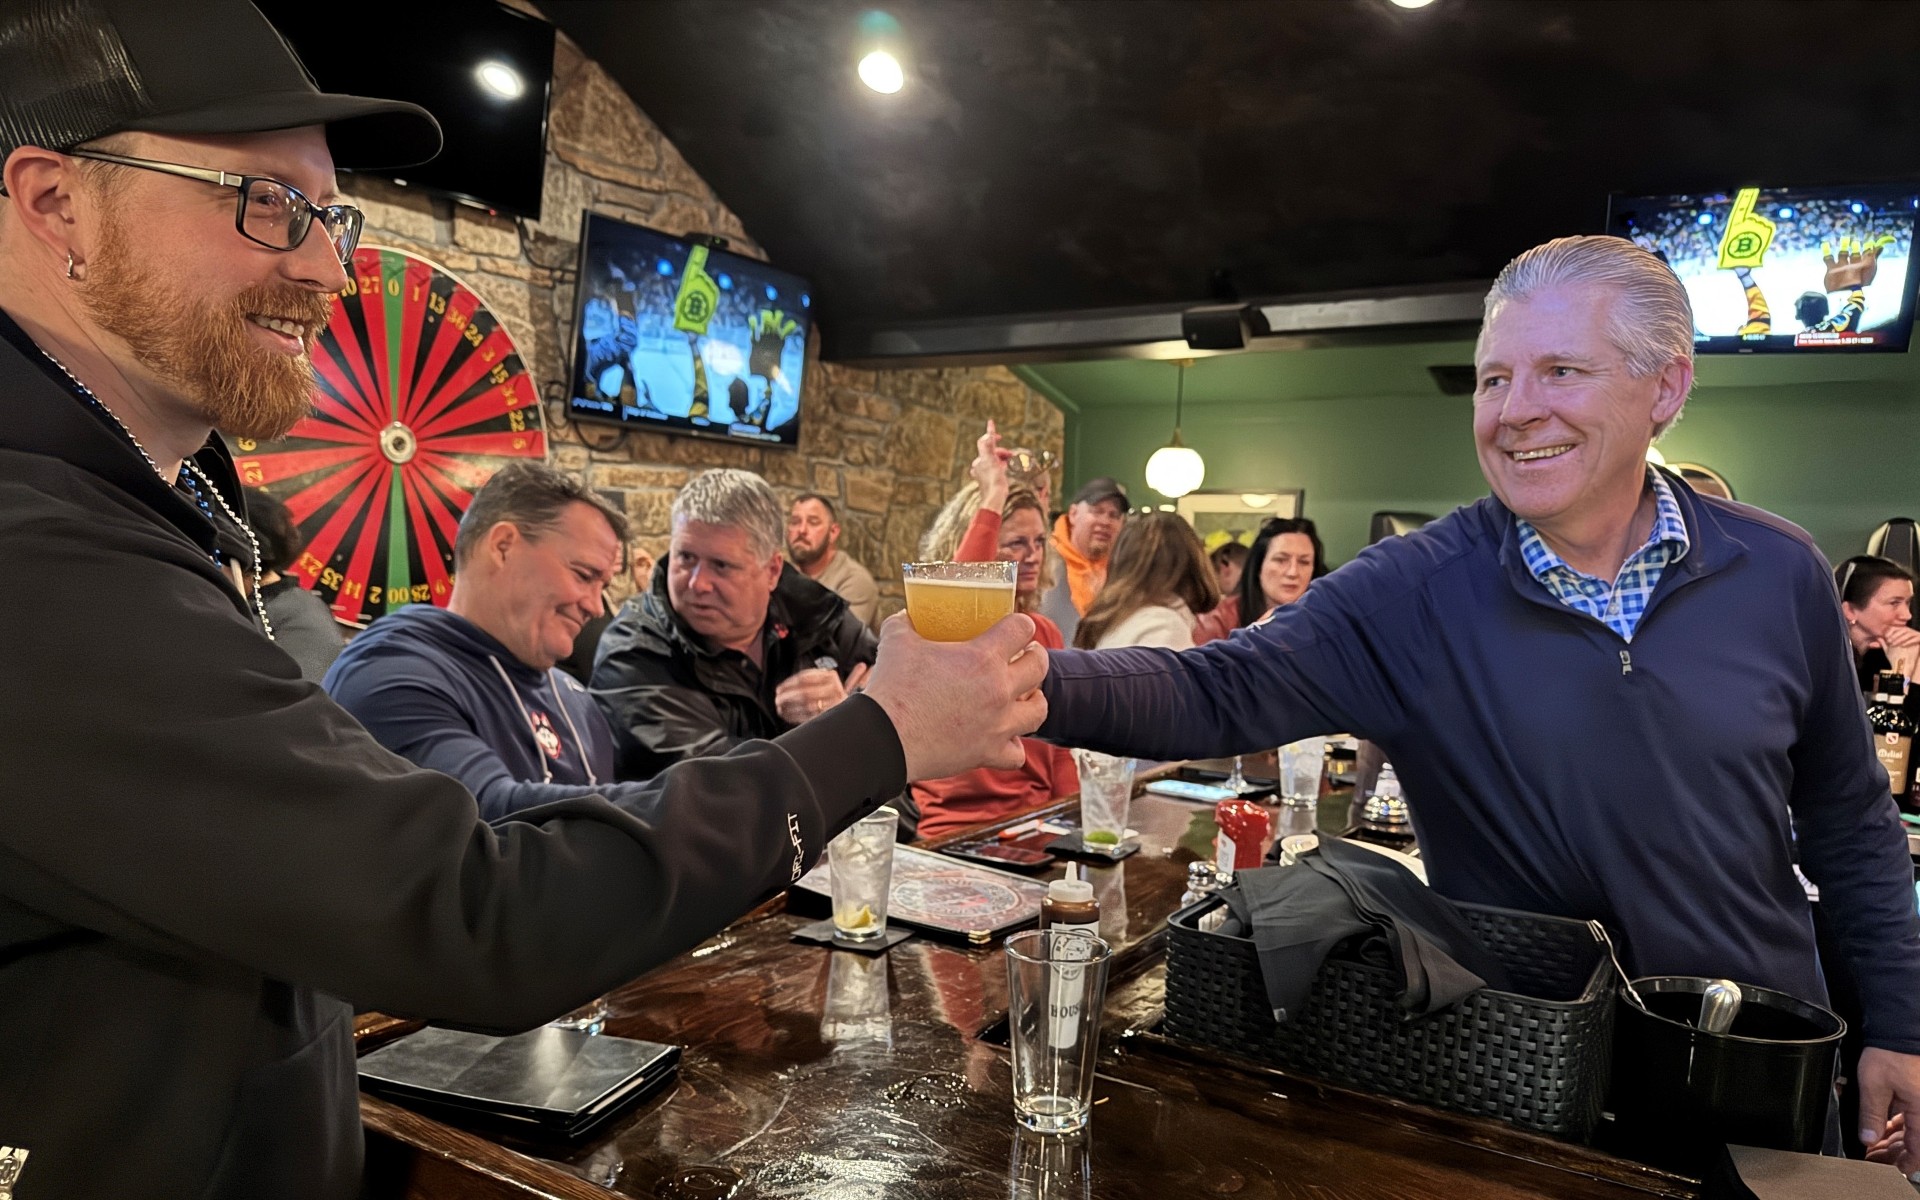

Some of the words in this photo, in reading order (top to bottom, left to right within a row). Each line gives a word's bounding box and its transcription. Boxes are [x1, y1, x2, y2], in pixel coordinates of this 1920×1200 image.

[360, 276, 379, 294] 27
[388, 278, 399, 296] 0
[413, 285, 420, 302] 1
[429, 292, 446, 314] 13
[464, 323, 484, 347] 24
[491, 362, 509, 384] 15
[509, 410, 526, 432] 22
[242, 461, 263, 483] 21
[300, 552, 323, 577] 23
[320, 567, 343, 591] 35
[345, 579, 362, 599] 14
[369, 586, 382, 604] 2
[388, 587, 409, 603] 00
[411, 584, 431, 602] 28
